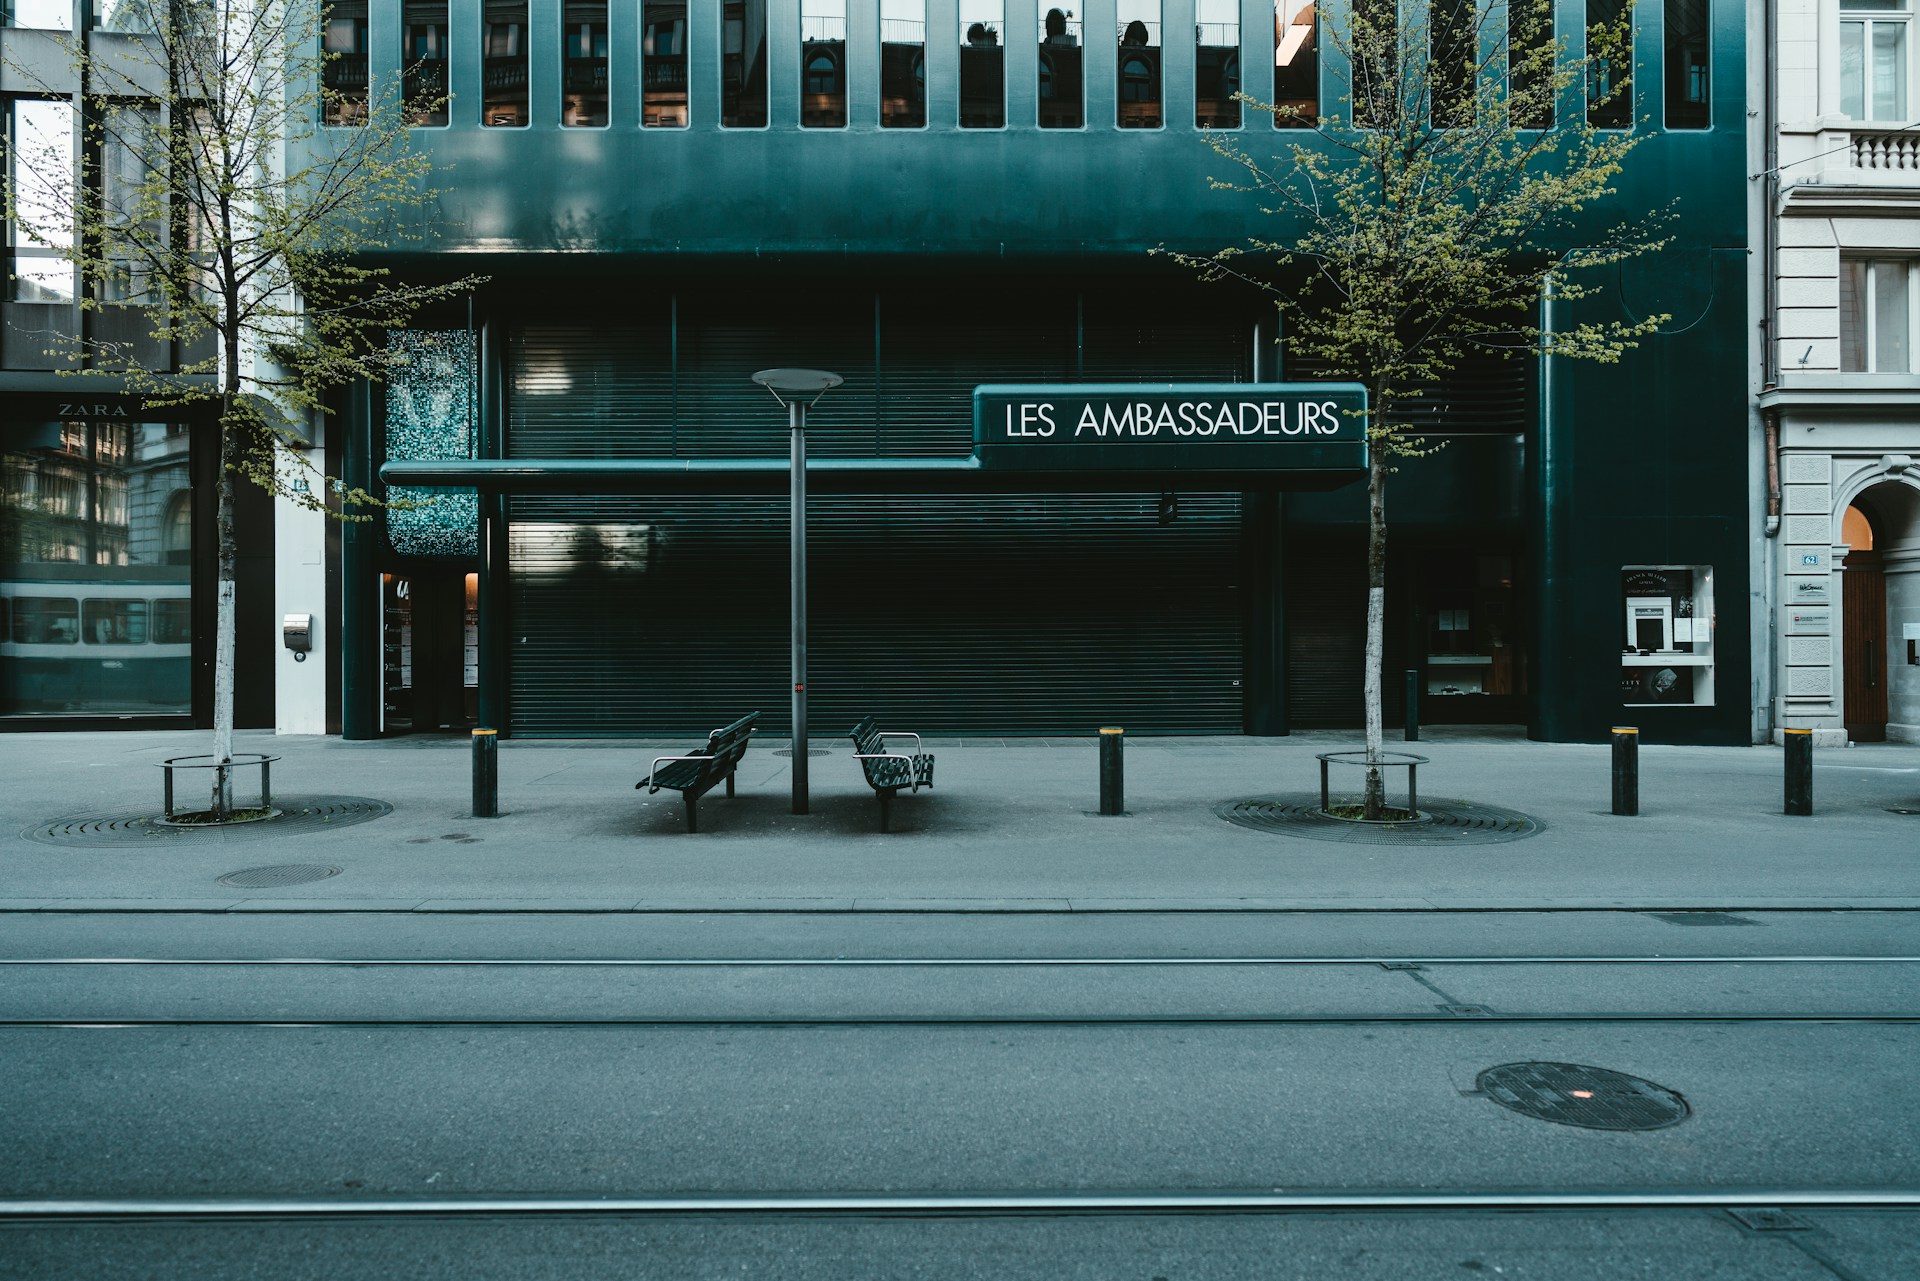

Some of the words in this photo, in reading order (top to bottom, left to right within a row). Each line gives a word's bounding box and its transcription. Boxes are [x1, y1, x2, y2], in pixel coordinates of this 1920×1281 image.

[58, 403, 128, 417] ZARA
[1006, 403, 1056, 437] LES
[1074, 401, 1339, 437] AMBASSADEURS
[1805, 556, 1816, 564] 62
